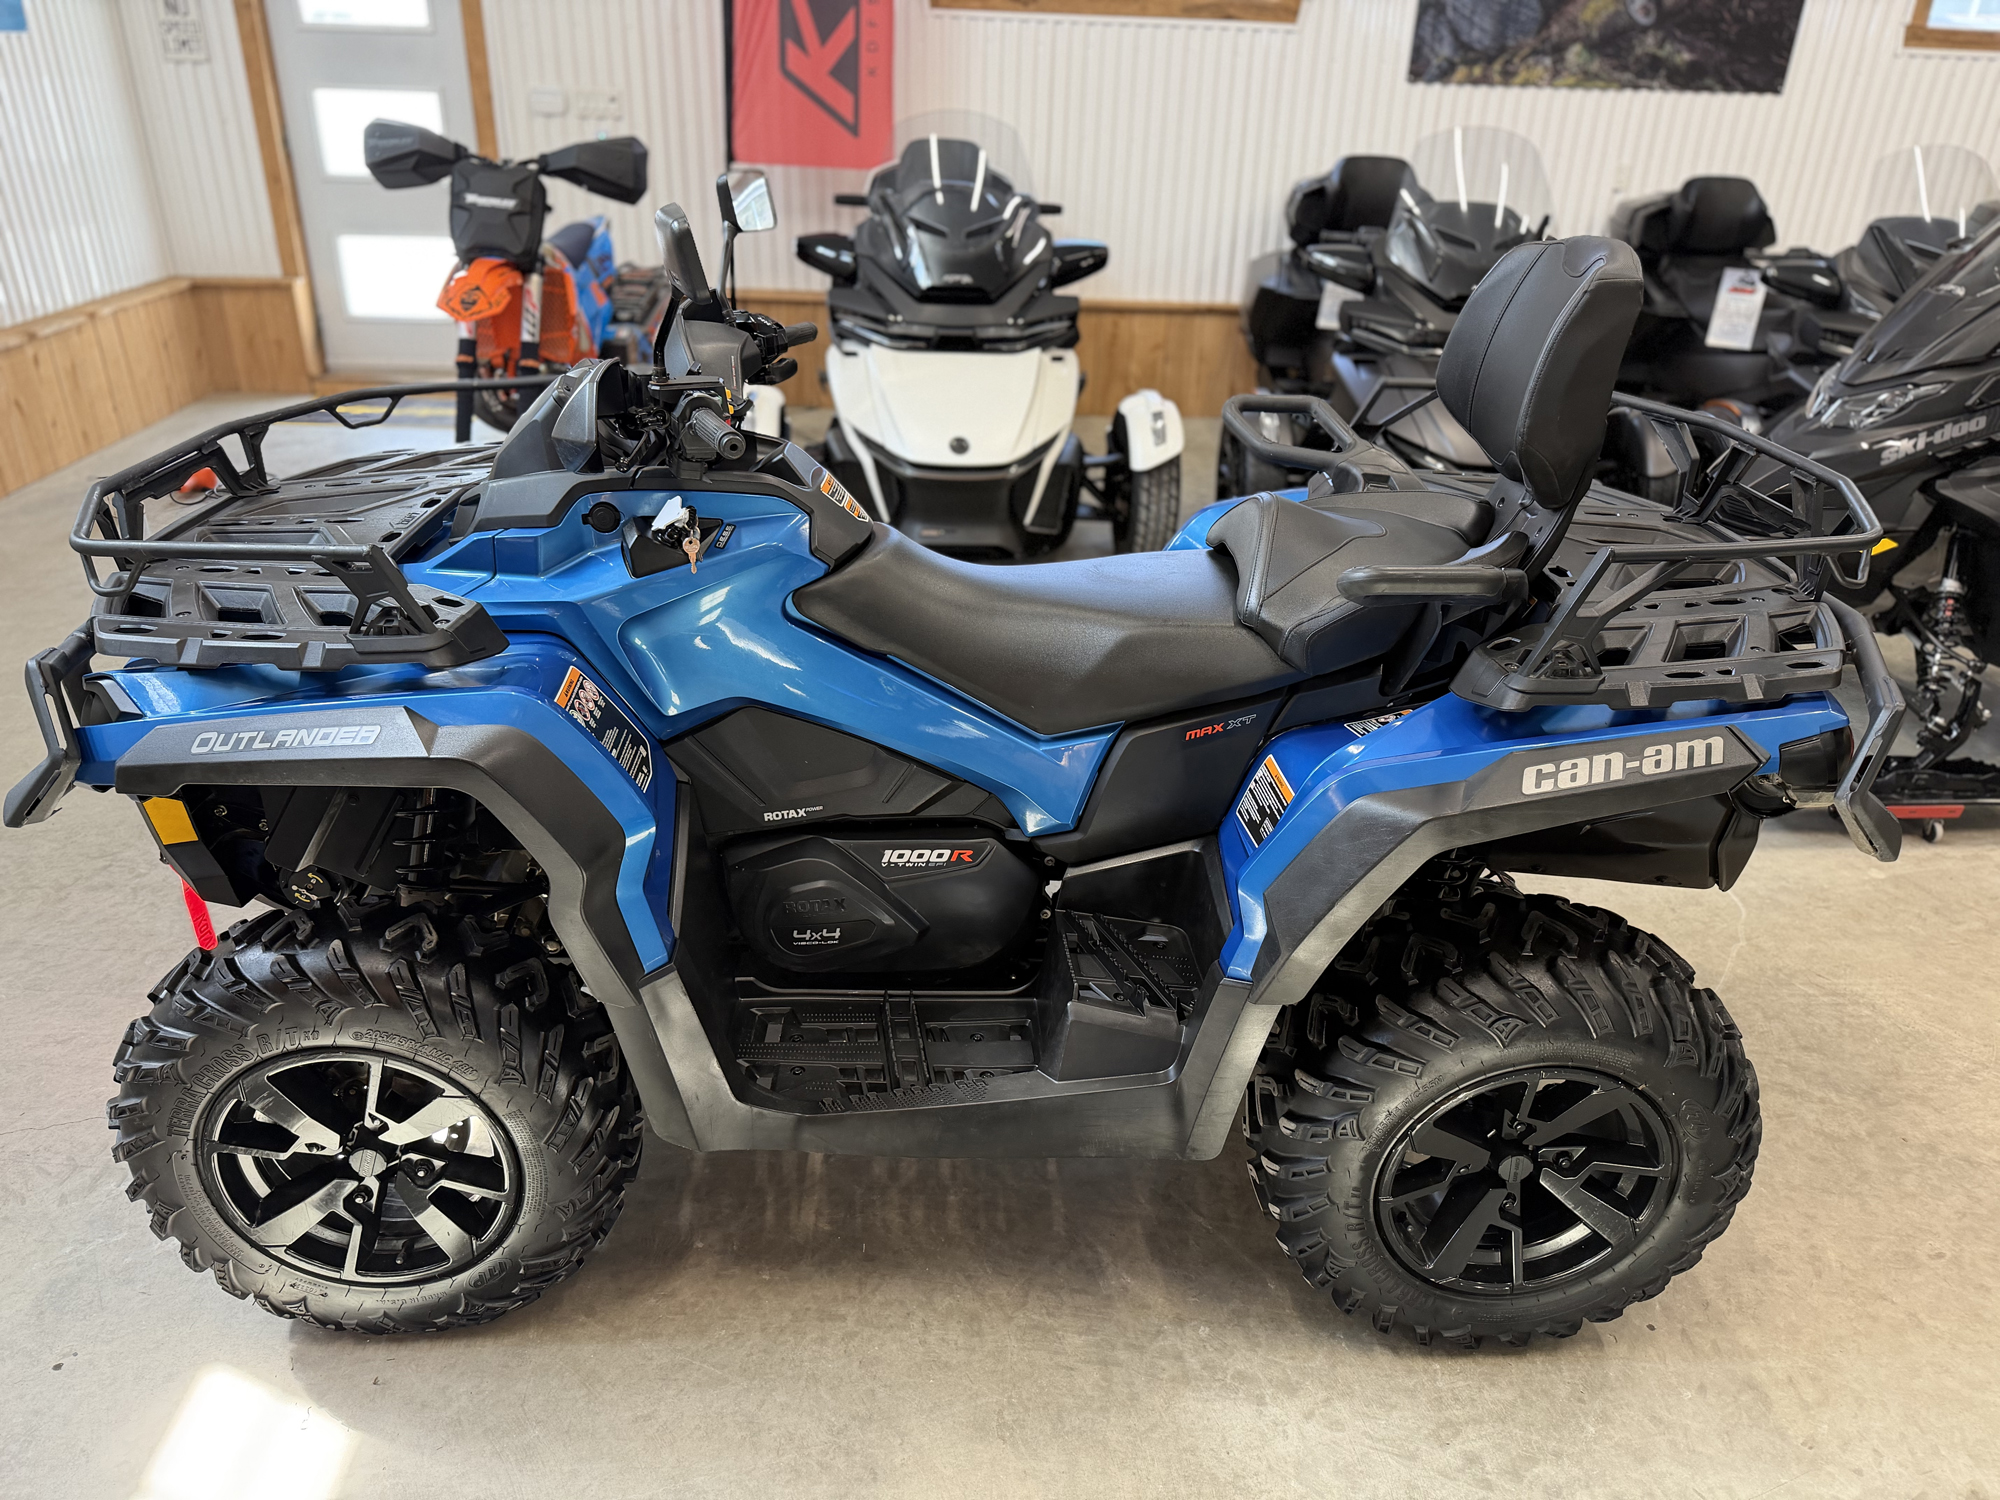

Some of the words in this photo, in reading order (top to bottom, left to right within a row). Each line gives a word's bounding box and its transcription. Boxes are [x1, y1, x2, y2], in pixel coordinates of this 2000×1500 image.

[1185, 722, 1225, 741] MAX
[1226, 713, 1257, 730] XT
[190, 725, 382, 754] OUTLANDER
[1521, 736, 1724, 795] can-am
[763, 807, 807, 822] ROTAX
[881, 849, 974, 862] 1000R
[783, 897, 847, 914] ROTAX
[793, 927, 841, 941] 4x4
